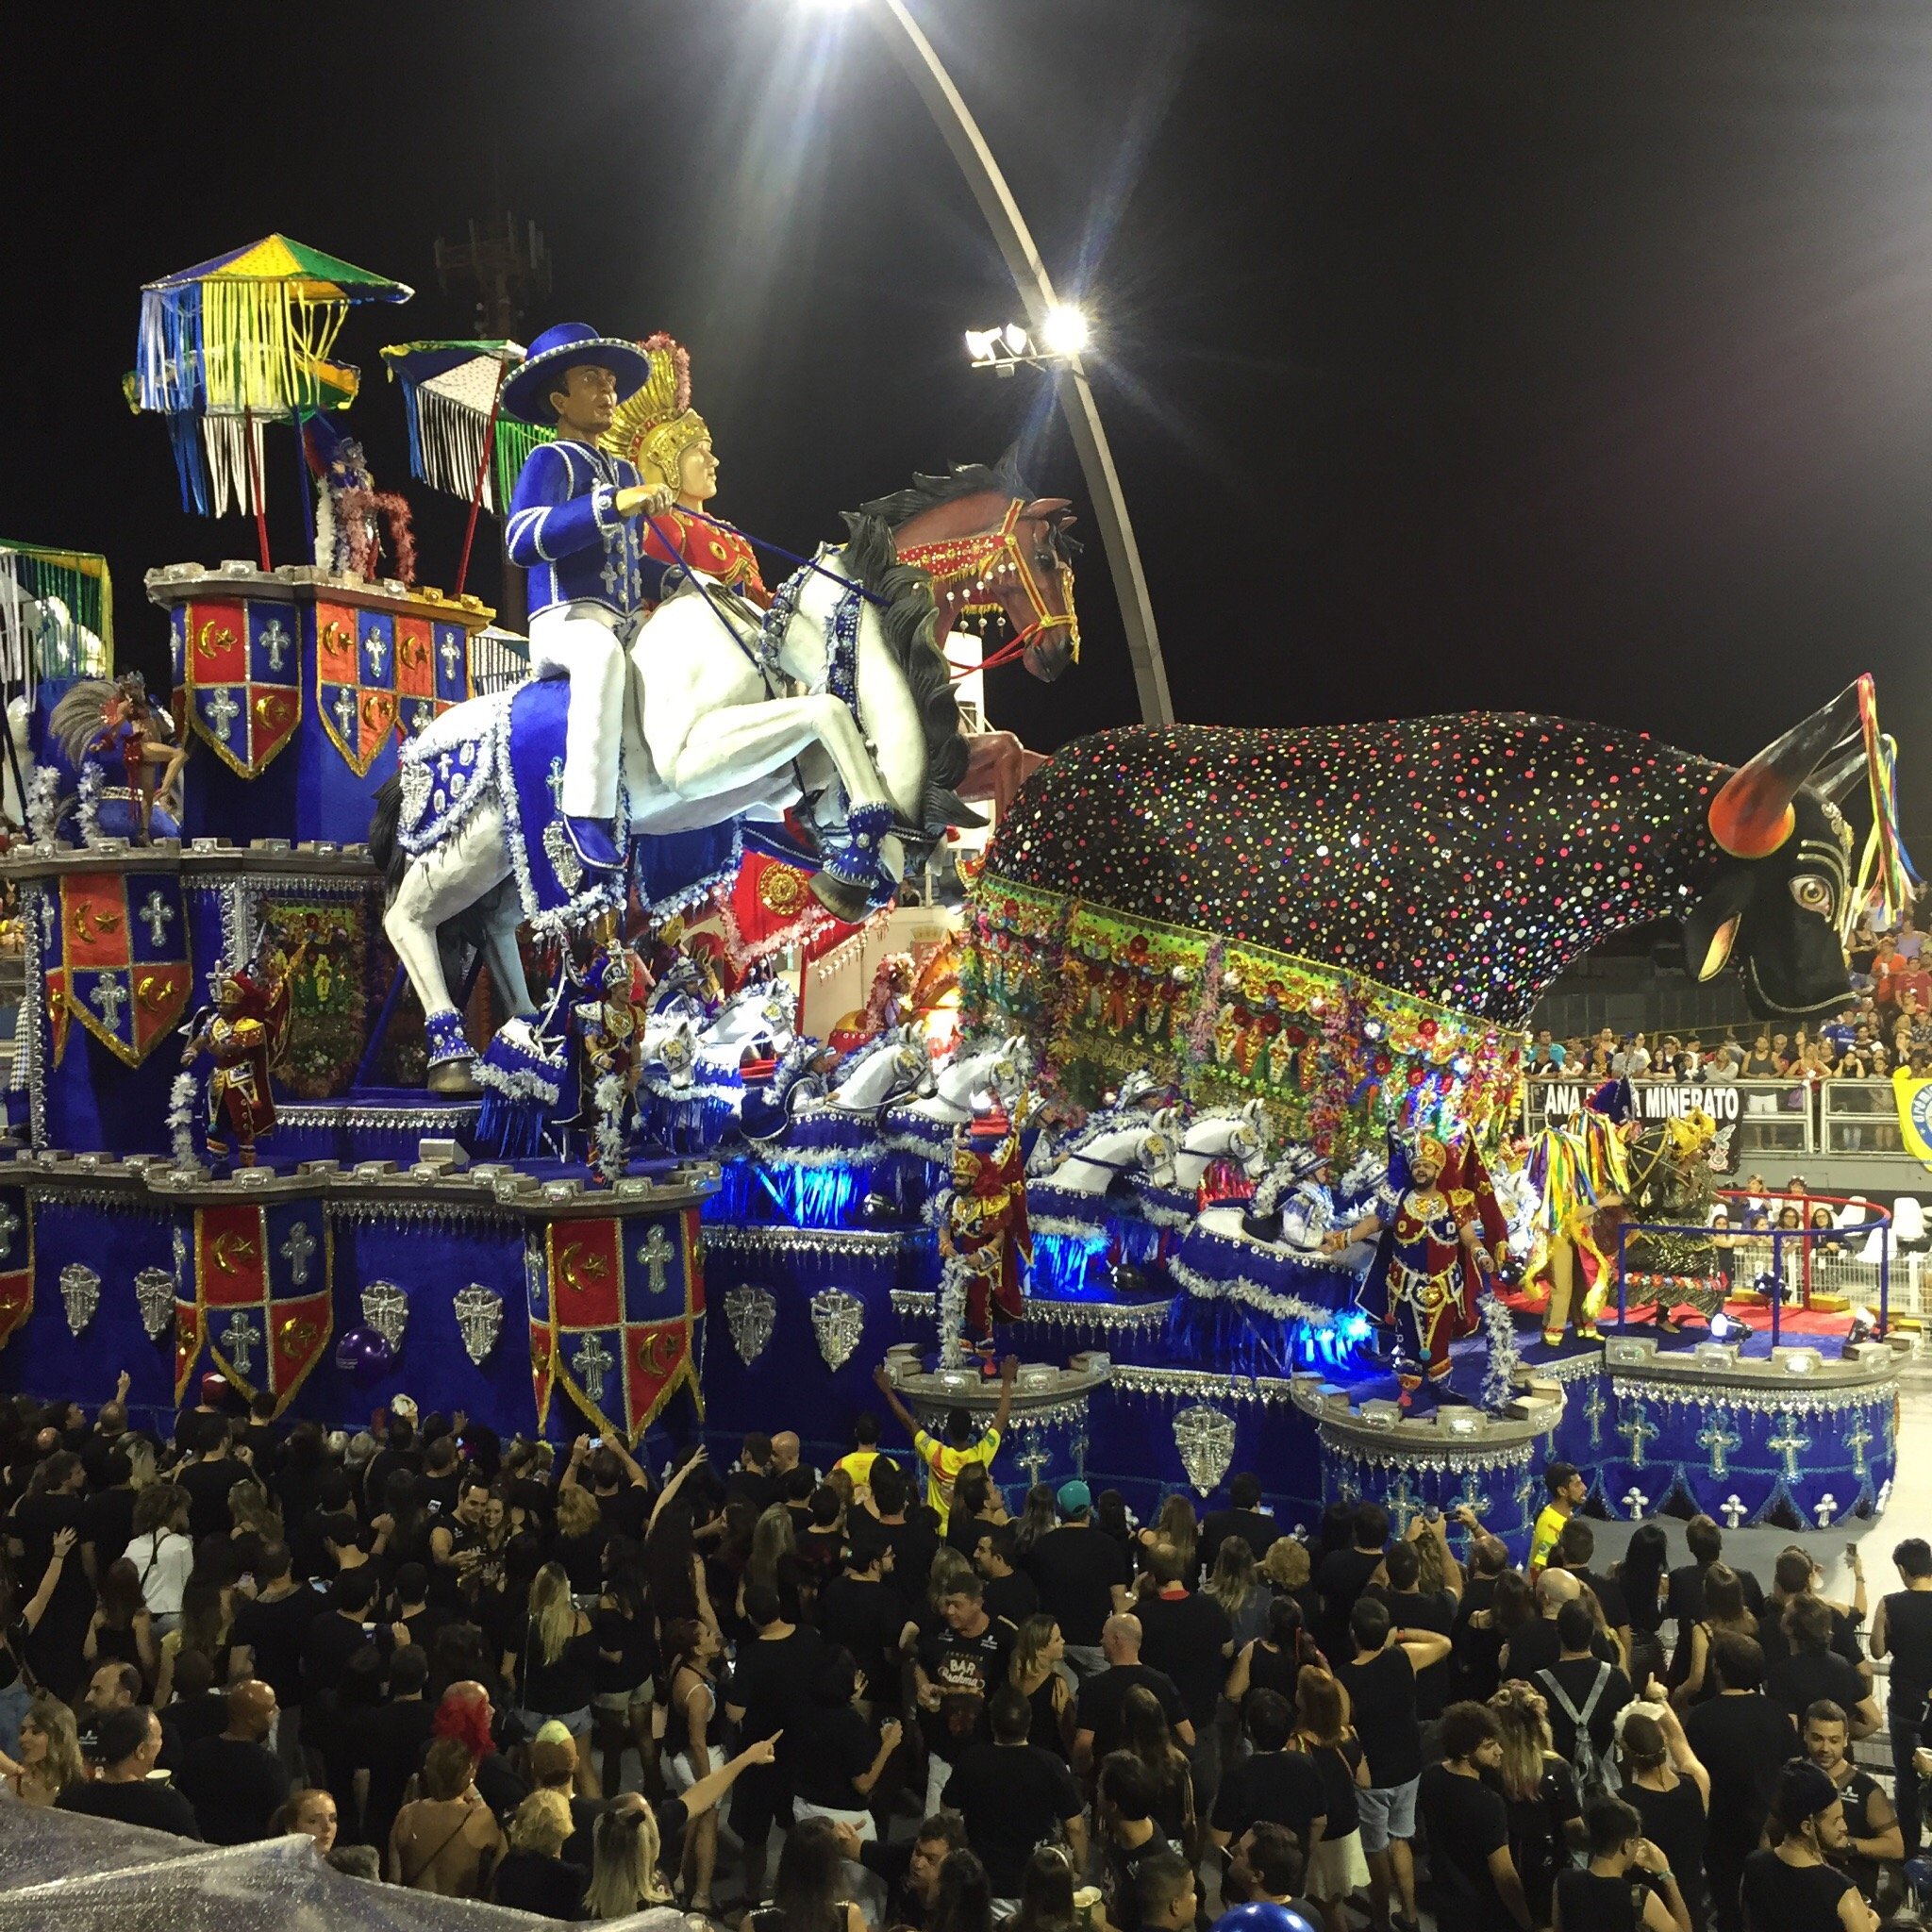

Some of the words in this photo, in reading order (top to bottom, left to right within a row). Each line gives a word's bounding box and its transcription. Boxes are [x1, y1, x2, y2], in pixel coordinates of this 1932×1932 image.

[1544, 1084, 1581, 1115] ANA
[1645, 1087, 1740, 1120] MINERATO
[938, 1666, 986, 1690] Brahma
[949, 1659, 976, 1675] BAR
